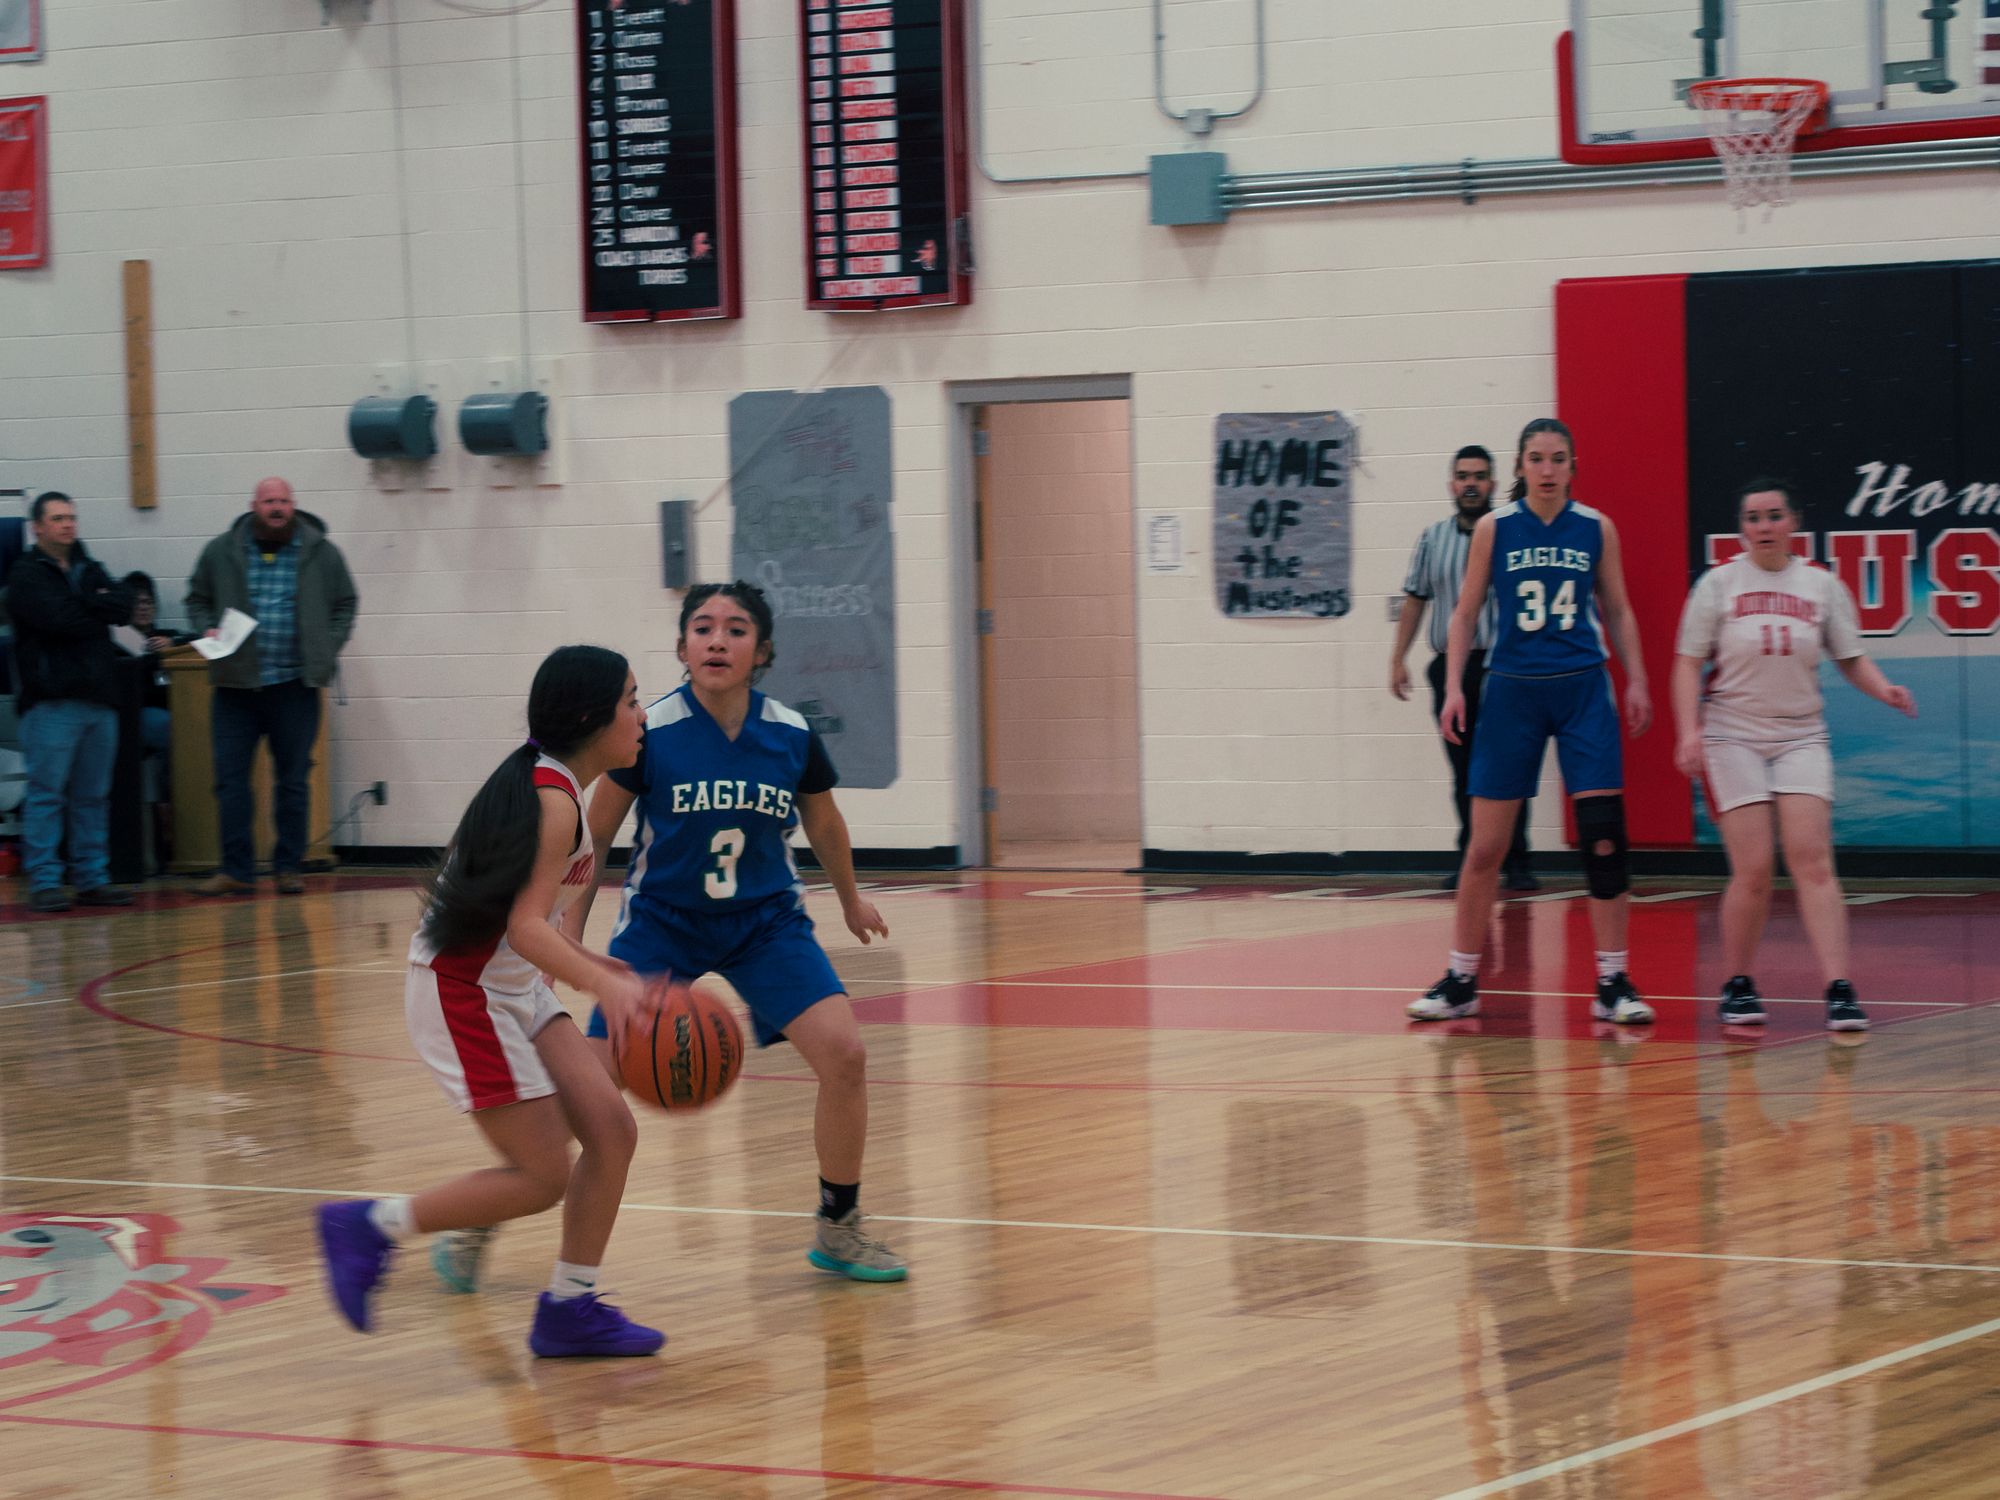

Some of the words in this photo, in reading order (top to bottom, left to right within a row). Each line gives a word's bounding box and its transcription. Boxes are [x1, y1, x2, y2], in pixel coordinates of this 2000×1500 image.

[1216, 438, 1342, 487] HOME
[1249, 499, 1302, 541] OF
[1234, 545, 1302, 579] the
[1506, 547, 1591, 573] EAGLES
[1706, 528, 2000, 637] US
[1516, 579, 1578, 632] 34
[1760, 624, 1794, 656] 11
[671, 780, 793, 819] EAGLES
[704, 827, 746, 899] 3
